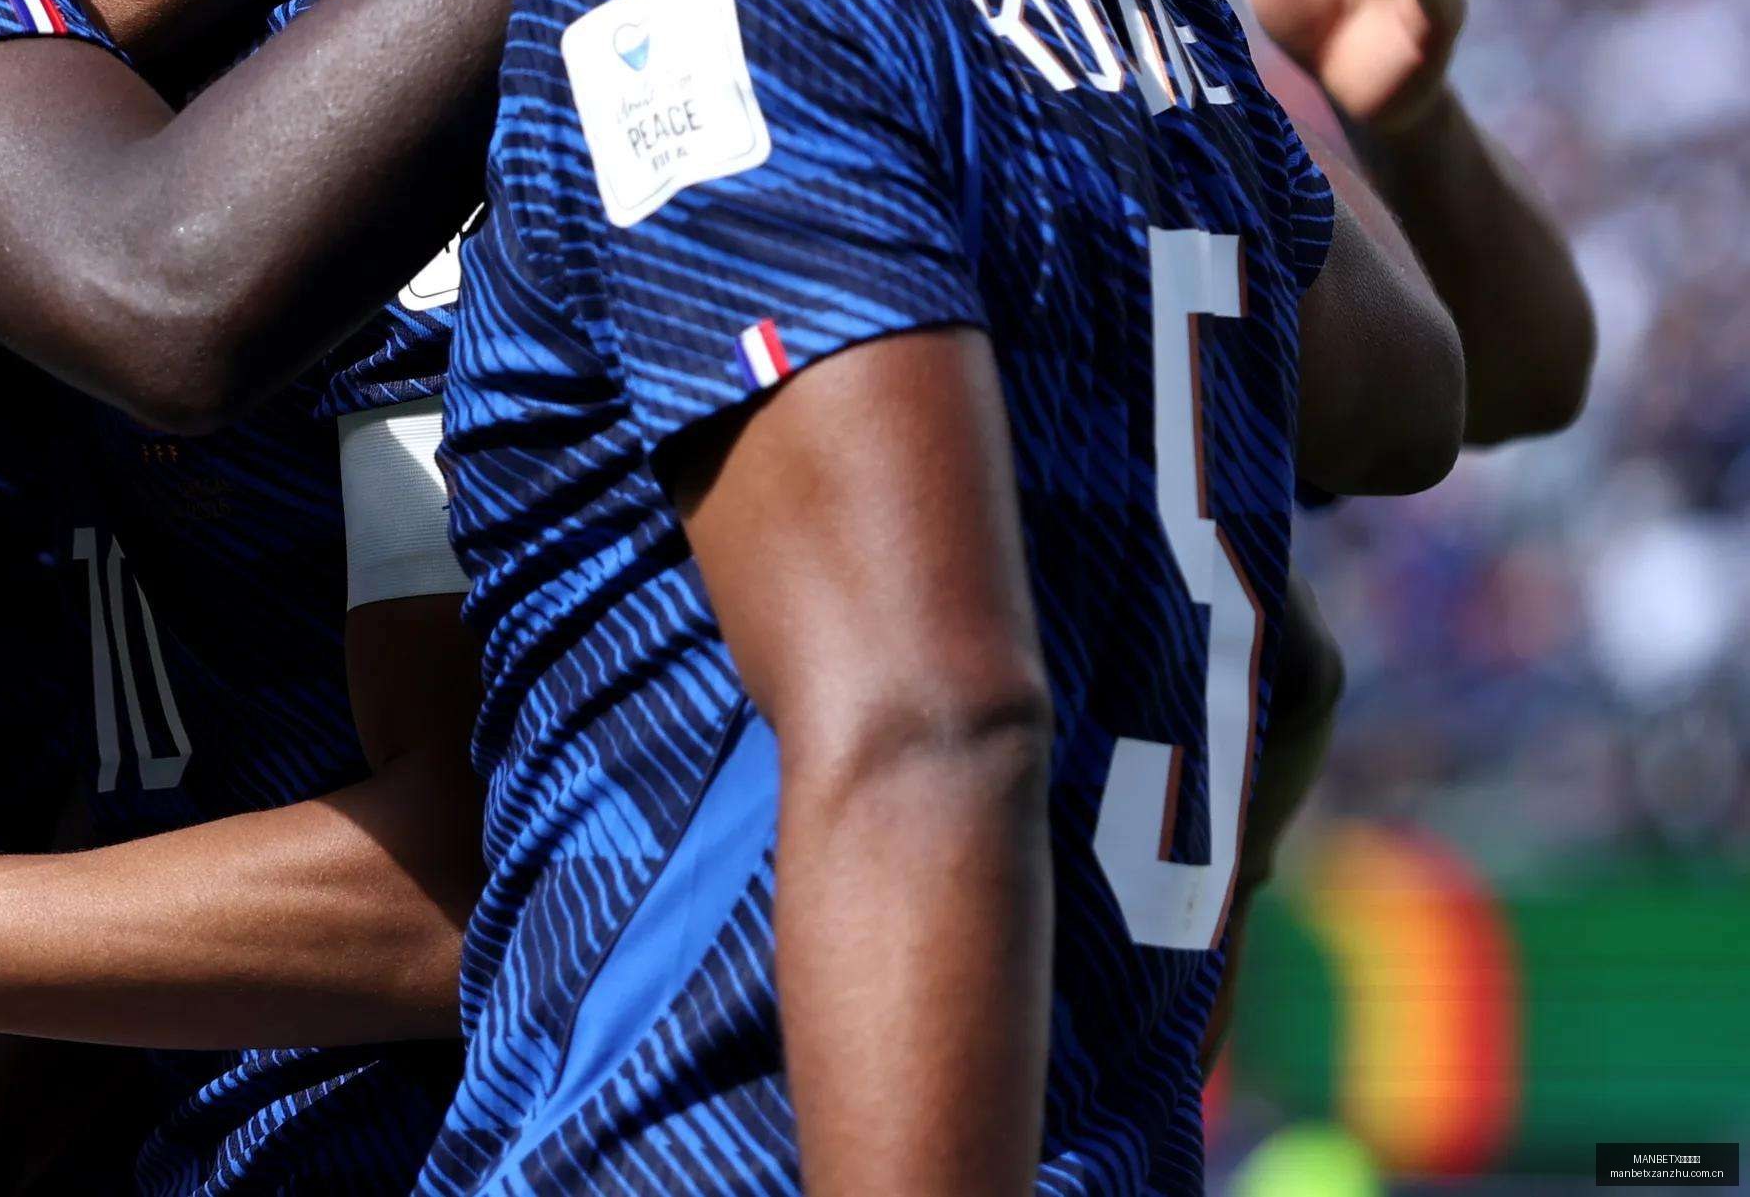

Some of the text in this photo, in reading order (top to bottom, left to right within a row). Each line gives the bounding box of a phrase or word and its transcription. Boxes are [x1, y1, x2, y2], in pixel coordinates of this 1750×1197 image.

[626, 99, 704, 159] PEACE
[72, 526, 193, 794] 10
[1092, 226, 1265, 951] 5
